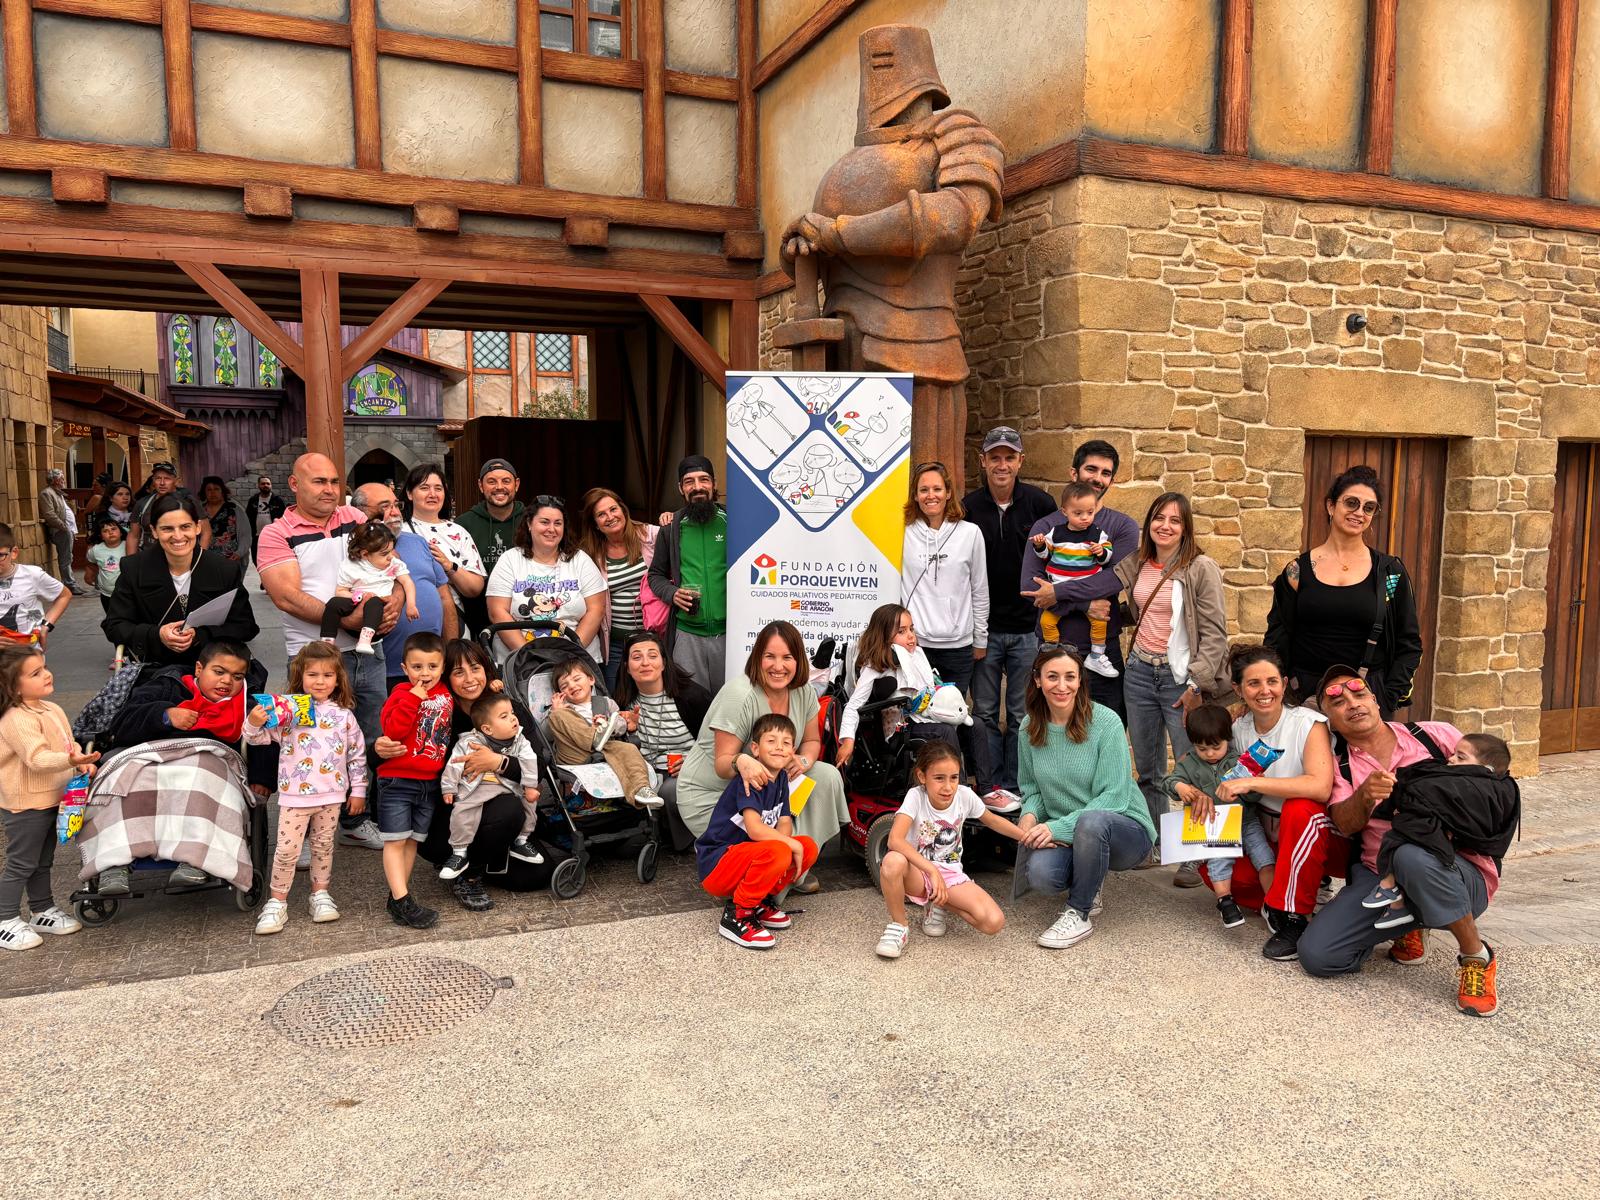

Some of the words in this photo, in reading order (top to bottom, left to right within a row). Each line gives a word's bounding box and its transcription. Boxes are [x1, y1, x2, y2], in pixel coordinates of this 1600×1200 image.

[780, 561, 878, 573] FUNDACIÓN
[780, 574, 878, 588] PORQUEVIVEN
[750, 590, 788, 598] CUIDADOS
[830, 592, 878, 601] PEDIÁTRICOS
[789, 618, 828, 628] podemos
[831, 619, 861, 629] ayudar
[801, 631, 815, 640] ida
